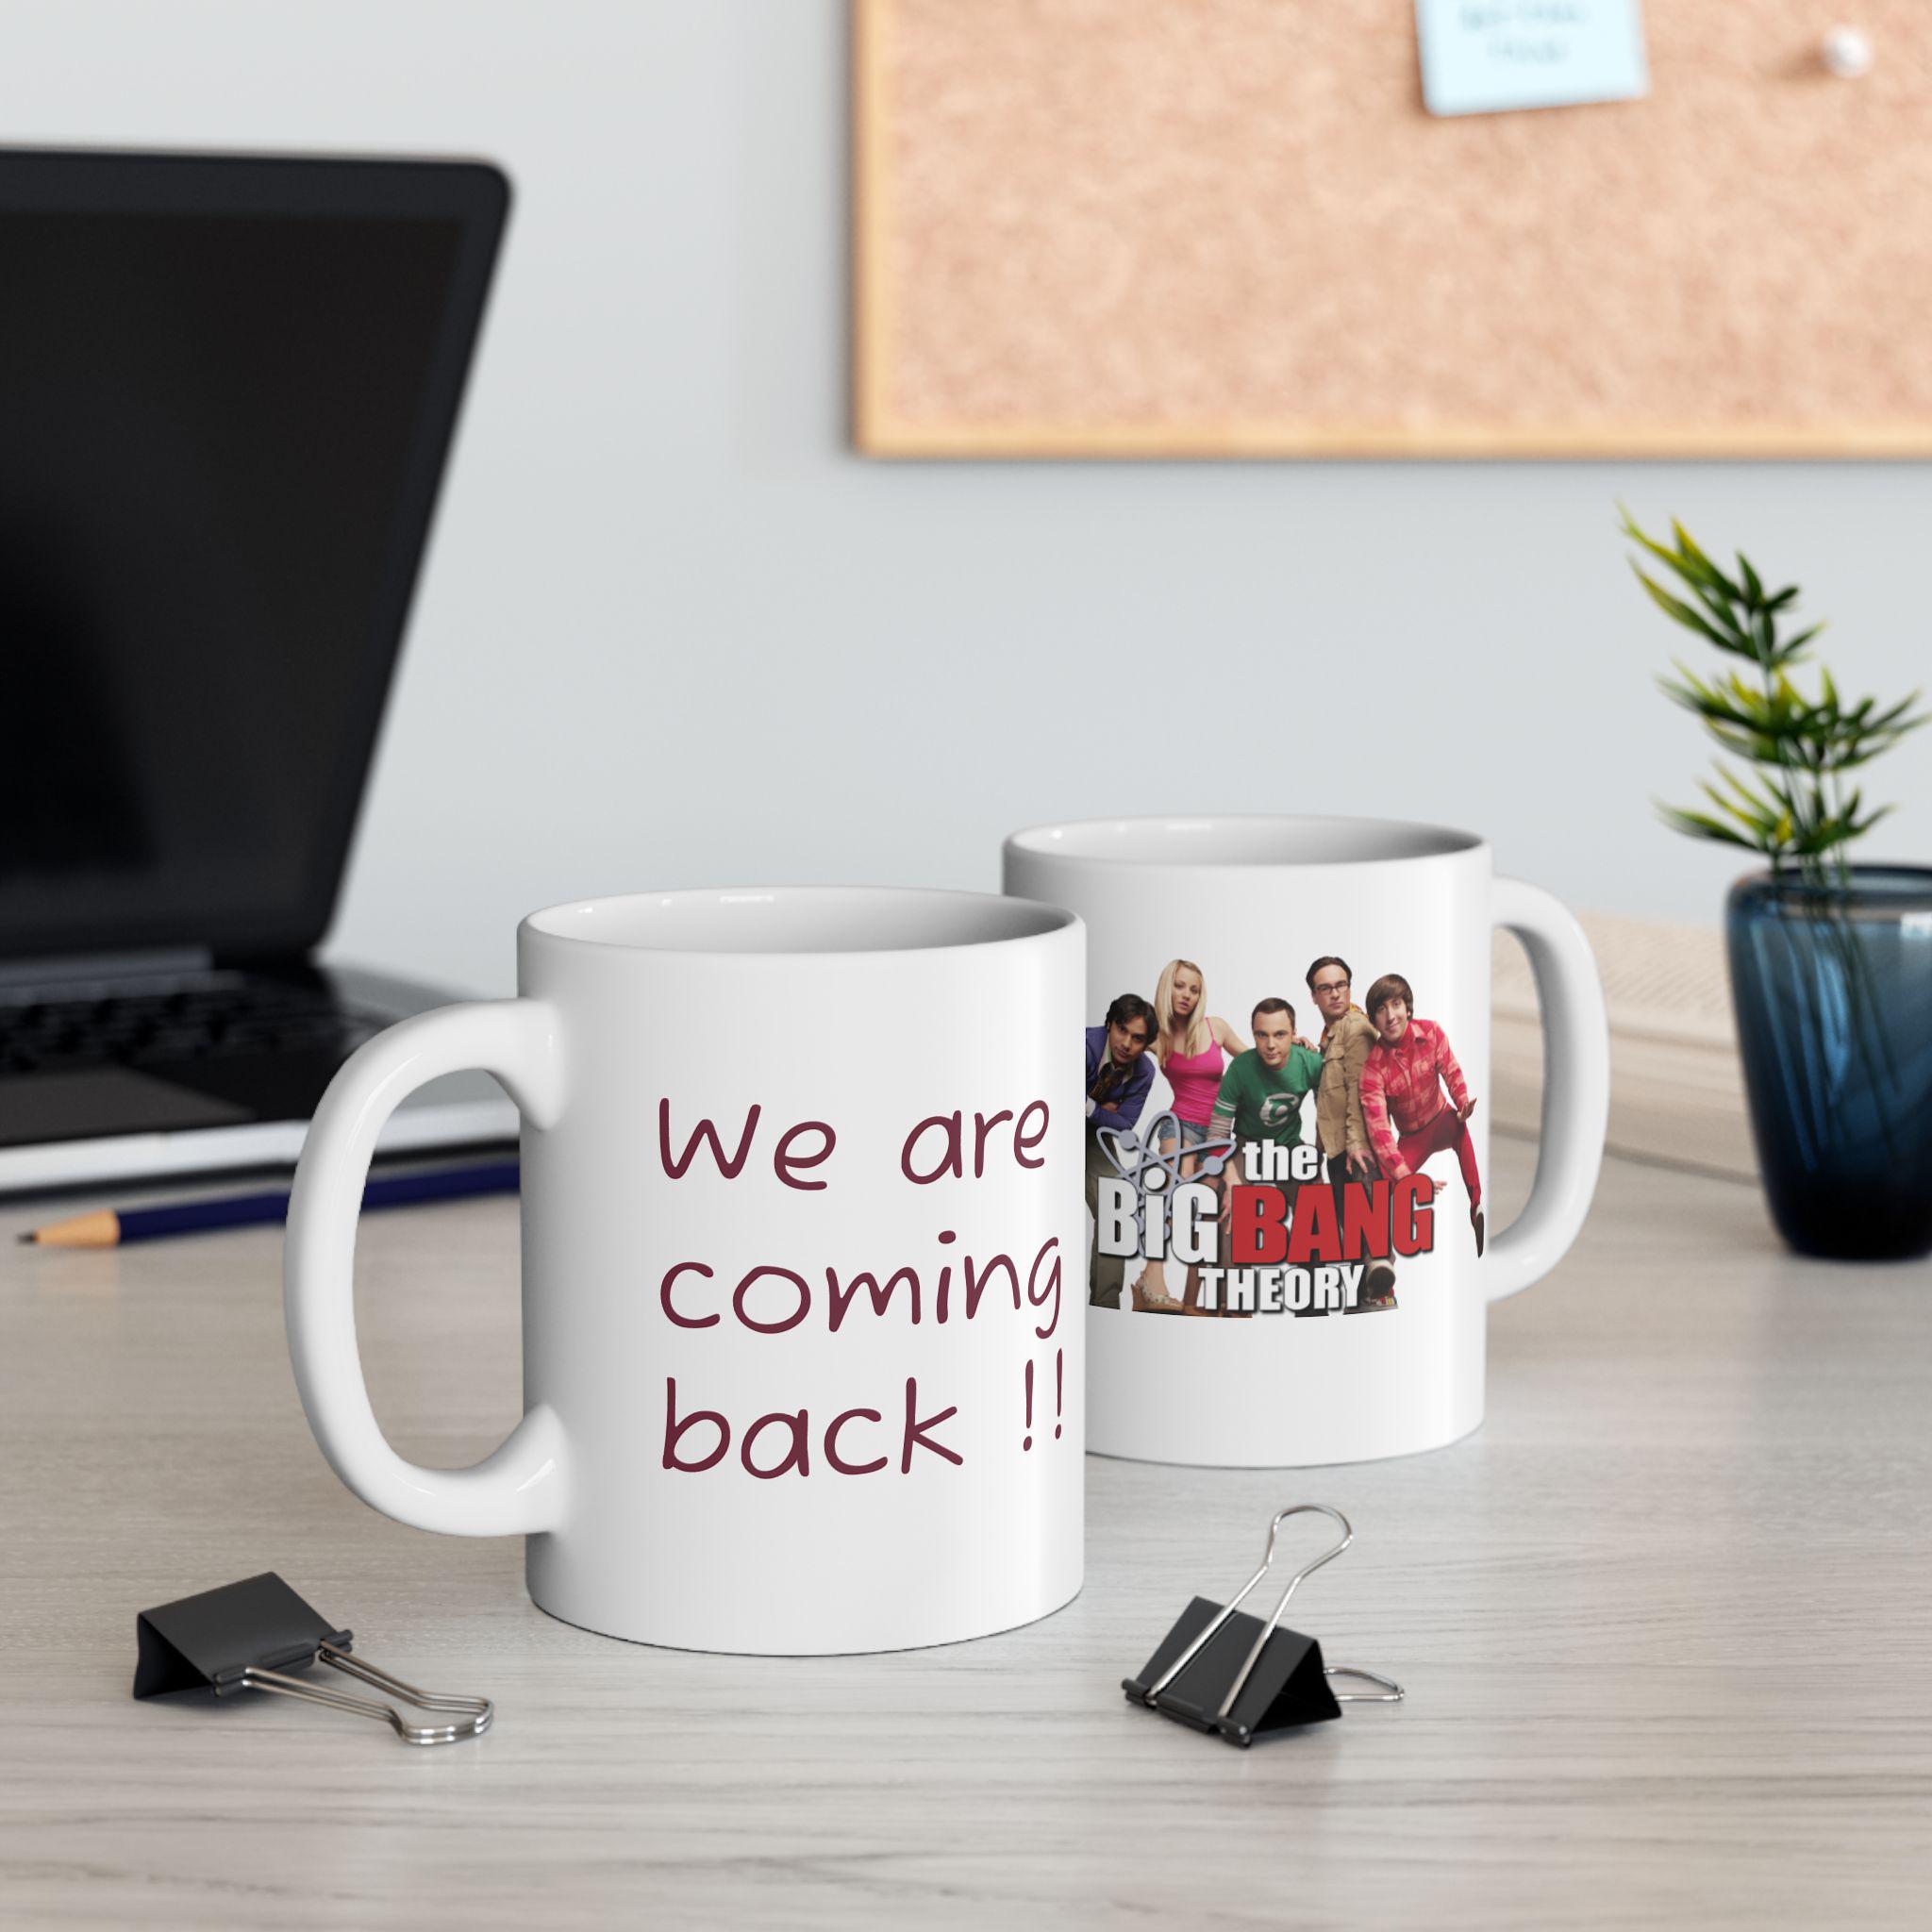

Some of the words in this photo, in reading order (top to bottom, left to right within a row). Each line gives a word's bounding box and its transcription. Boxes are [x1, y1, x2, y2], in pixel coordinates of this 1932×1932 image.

[658, 1097, 837, 1191] We
[901, 1099, 1050, 1185] are
[1241, 1138, 1319, 1181] the
[1230, 1173, 1435, 1264] BANG
[660, 1229, 1062, 1340] coming
[1197, 1263, 1365, 1312] THEORY
[662, 1376, 964, 1479] back
